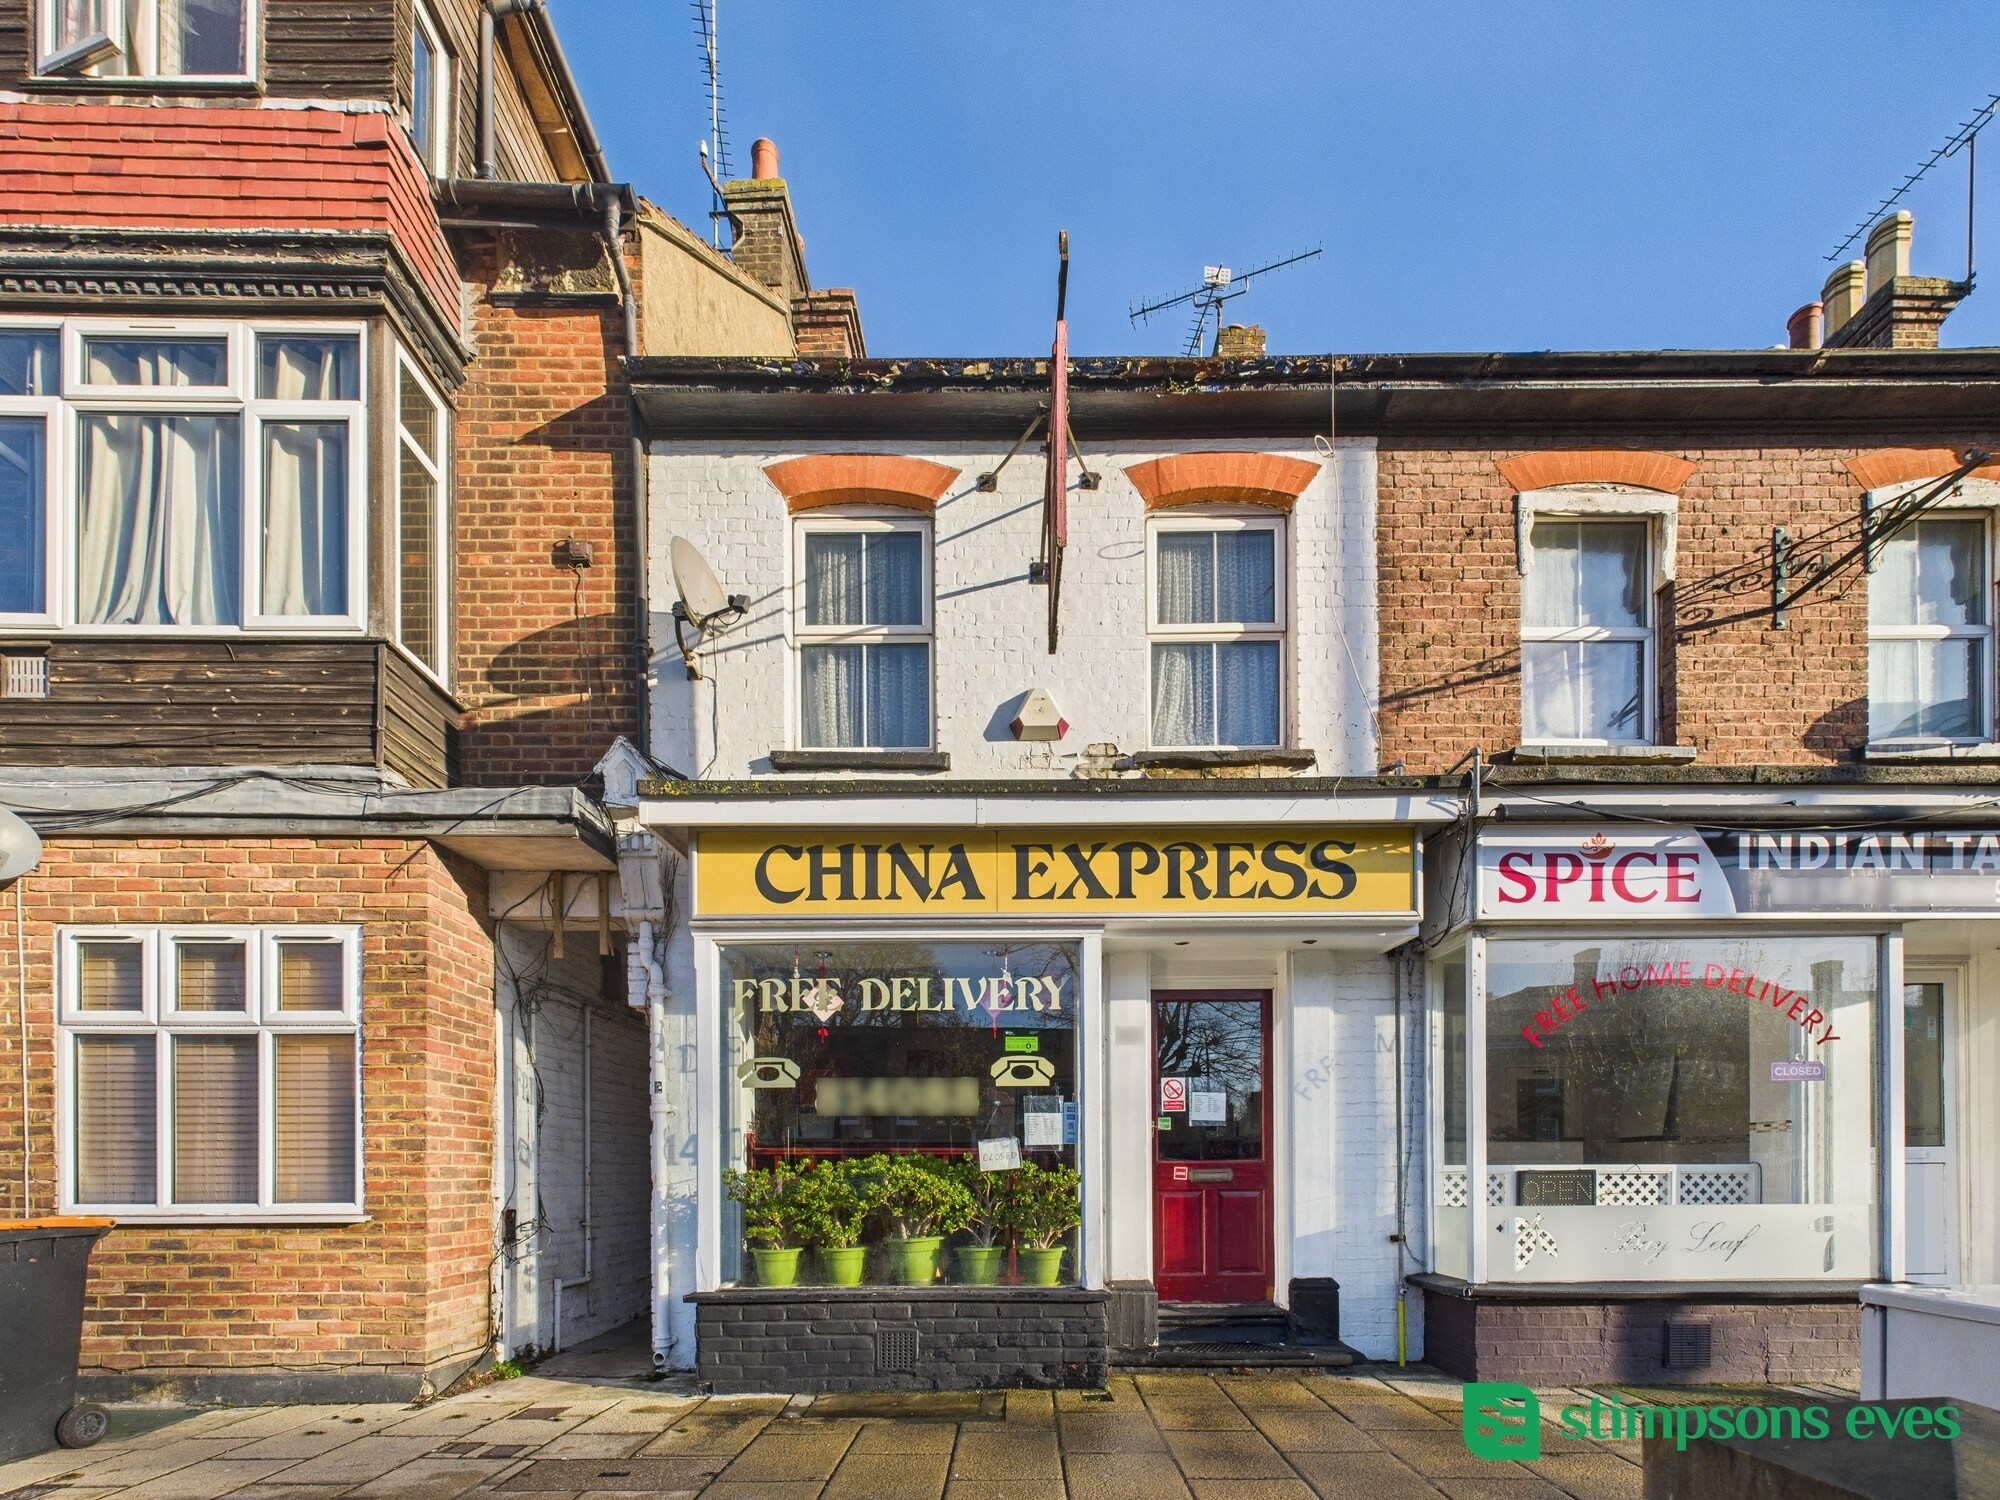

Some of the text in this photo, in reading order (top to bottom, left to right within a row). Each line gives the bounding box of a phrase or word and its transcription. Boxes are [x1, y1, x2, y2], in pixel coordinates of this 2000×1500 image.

[1738, 832, 1925, 870] INDIAN
[755, 841, 1357, 903] CHINA EXPRESS
[733, 976, 1068, 1013] FREE DELIVERY
[1521, 961, 1841, 1048] FREE HOME DELIVERY
[1774, 1066, 1821, 1076] CLOSED
[983, 1152, 1017, 1161] CLOSED
[1523, 1180, 1592, 1201] OPEN
[1604, 1221, 1761, 1265] Bay Leaf
